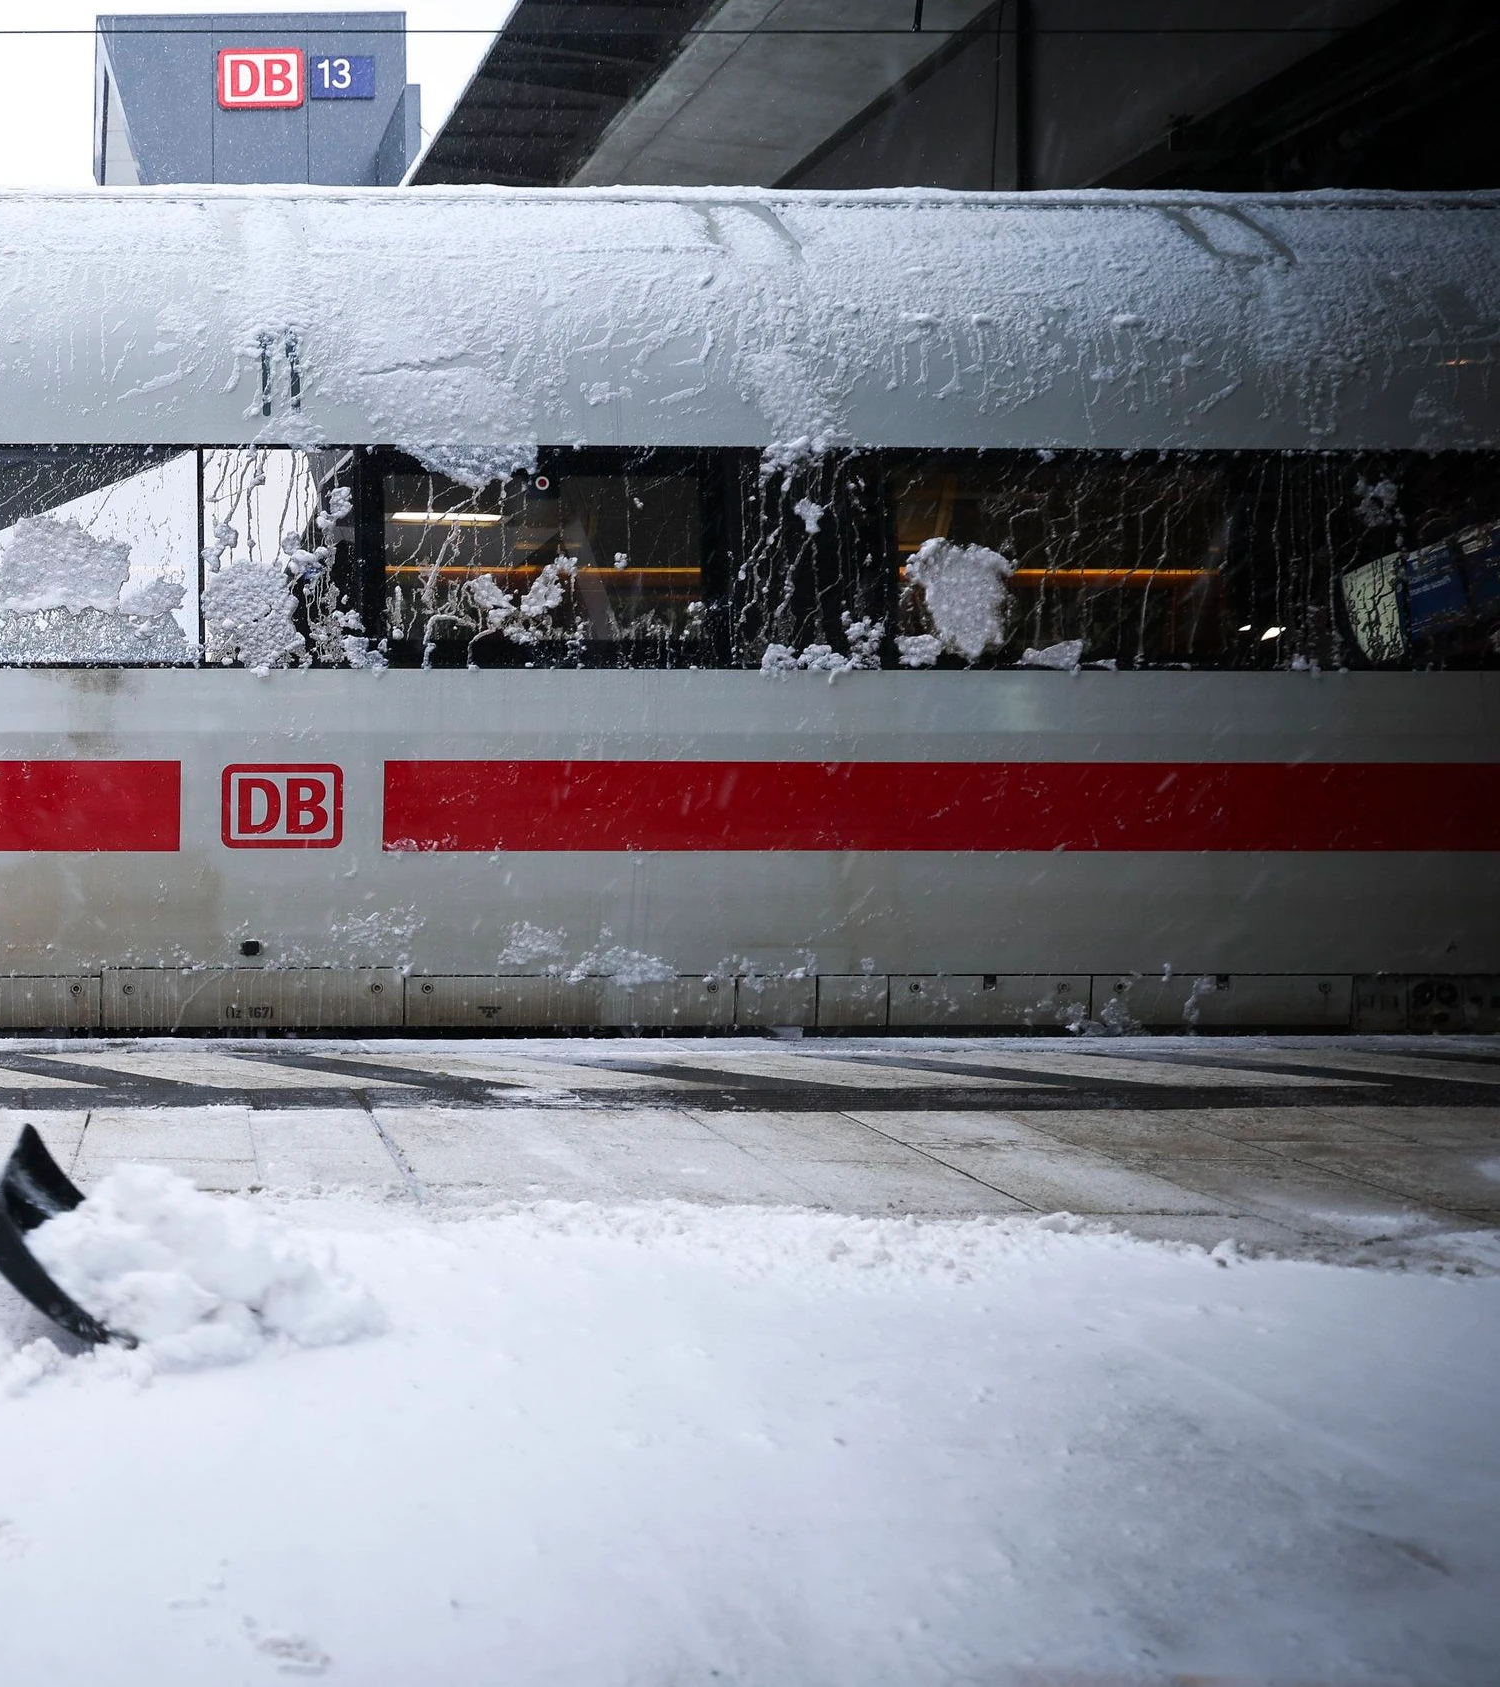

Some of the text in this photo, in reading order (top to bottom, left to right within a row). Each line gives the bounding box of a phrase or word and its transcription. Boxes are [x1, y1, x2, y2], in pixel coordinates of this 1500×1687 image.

[230, 59, 293, 97] DB
[317, 58, 352, 89] 13
[237, 777, 329, 834] DB
